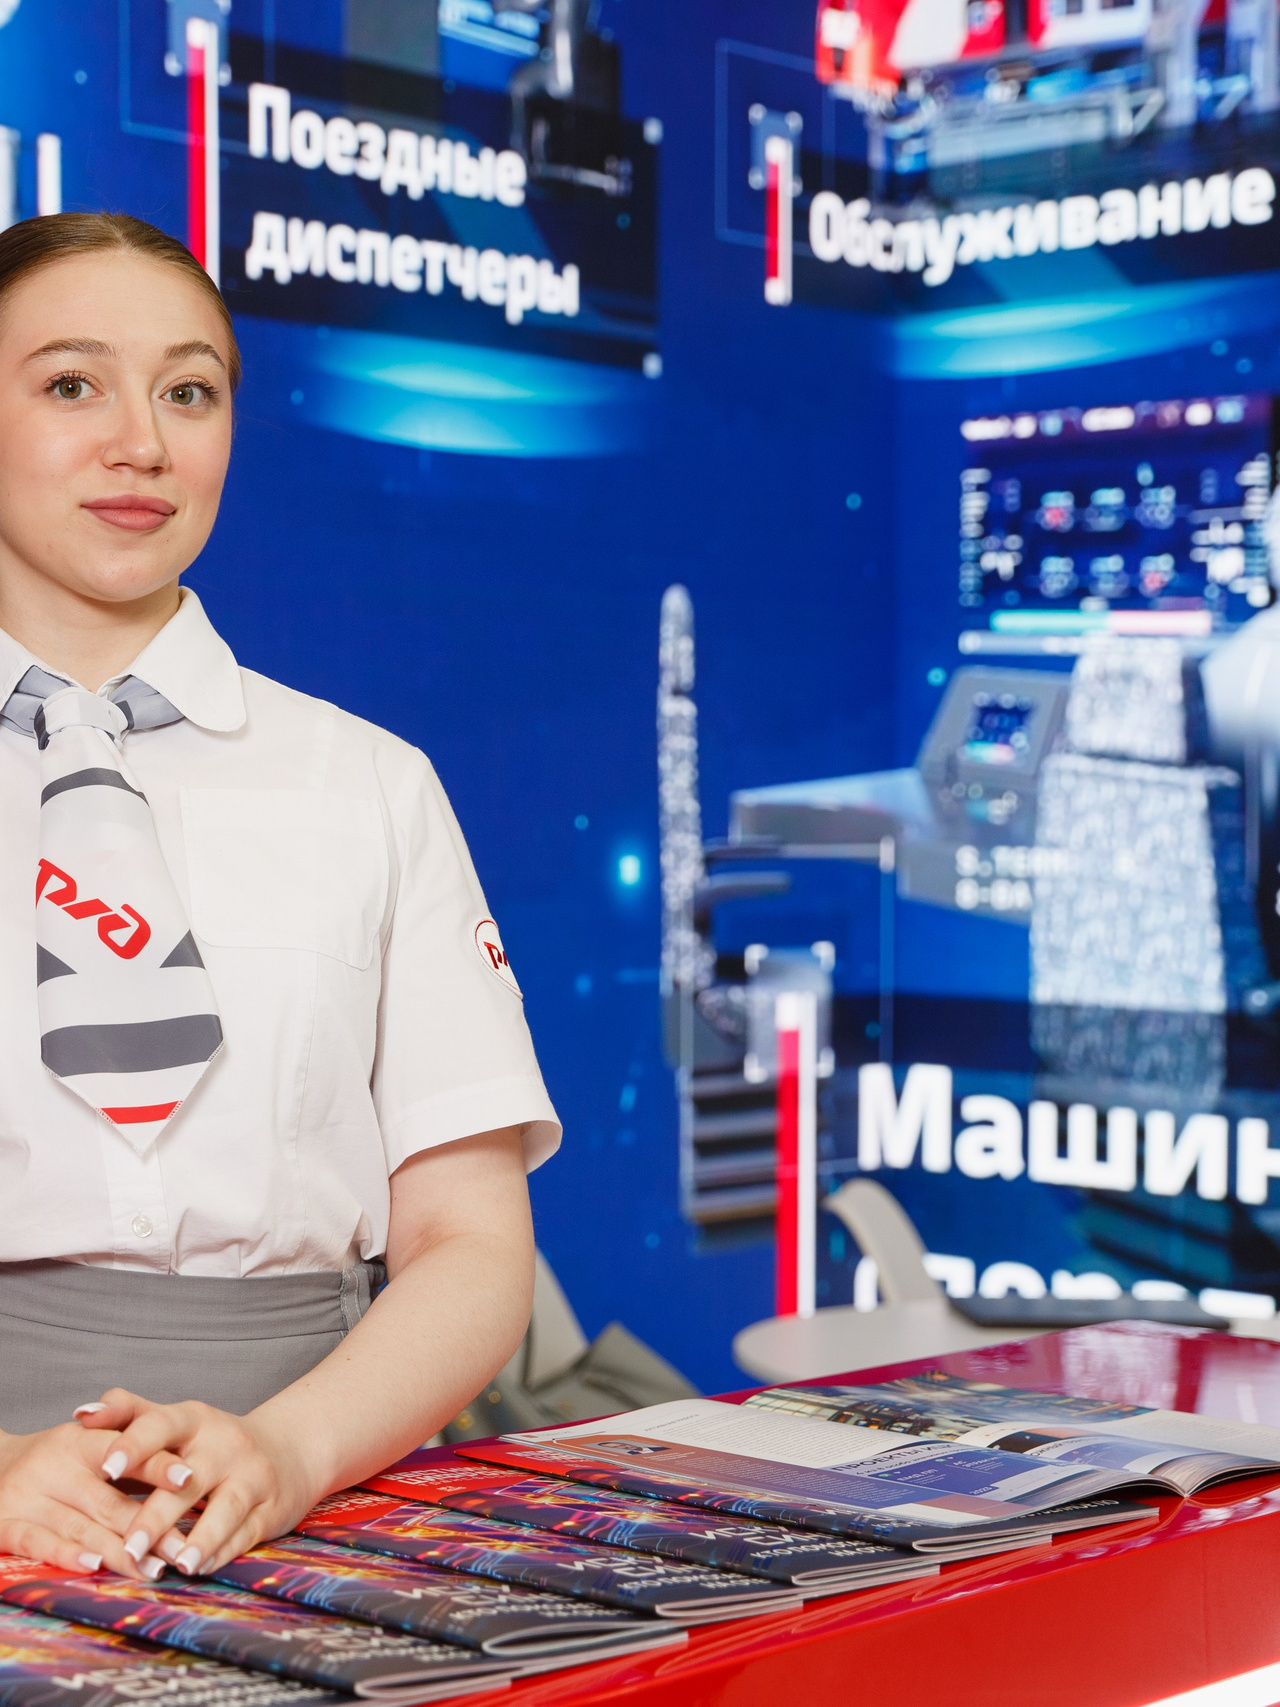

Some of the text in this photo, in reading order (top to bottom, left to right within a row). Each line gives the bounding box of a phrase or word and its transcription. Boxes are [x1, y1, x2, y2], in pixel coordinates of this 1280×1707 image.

[248, 83, 528, 207] Поездные
[245, 211, 580, 326] диспетчеры
[808, 167, 1276, 287] Обслуживание
